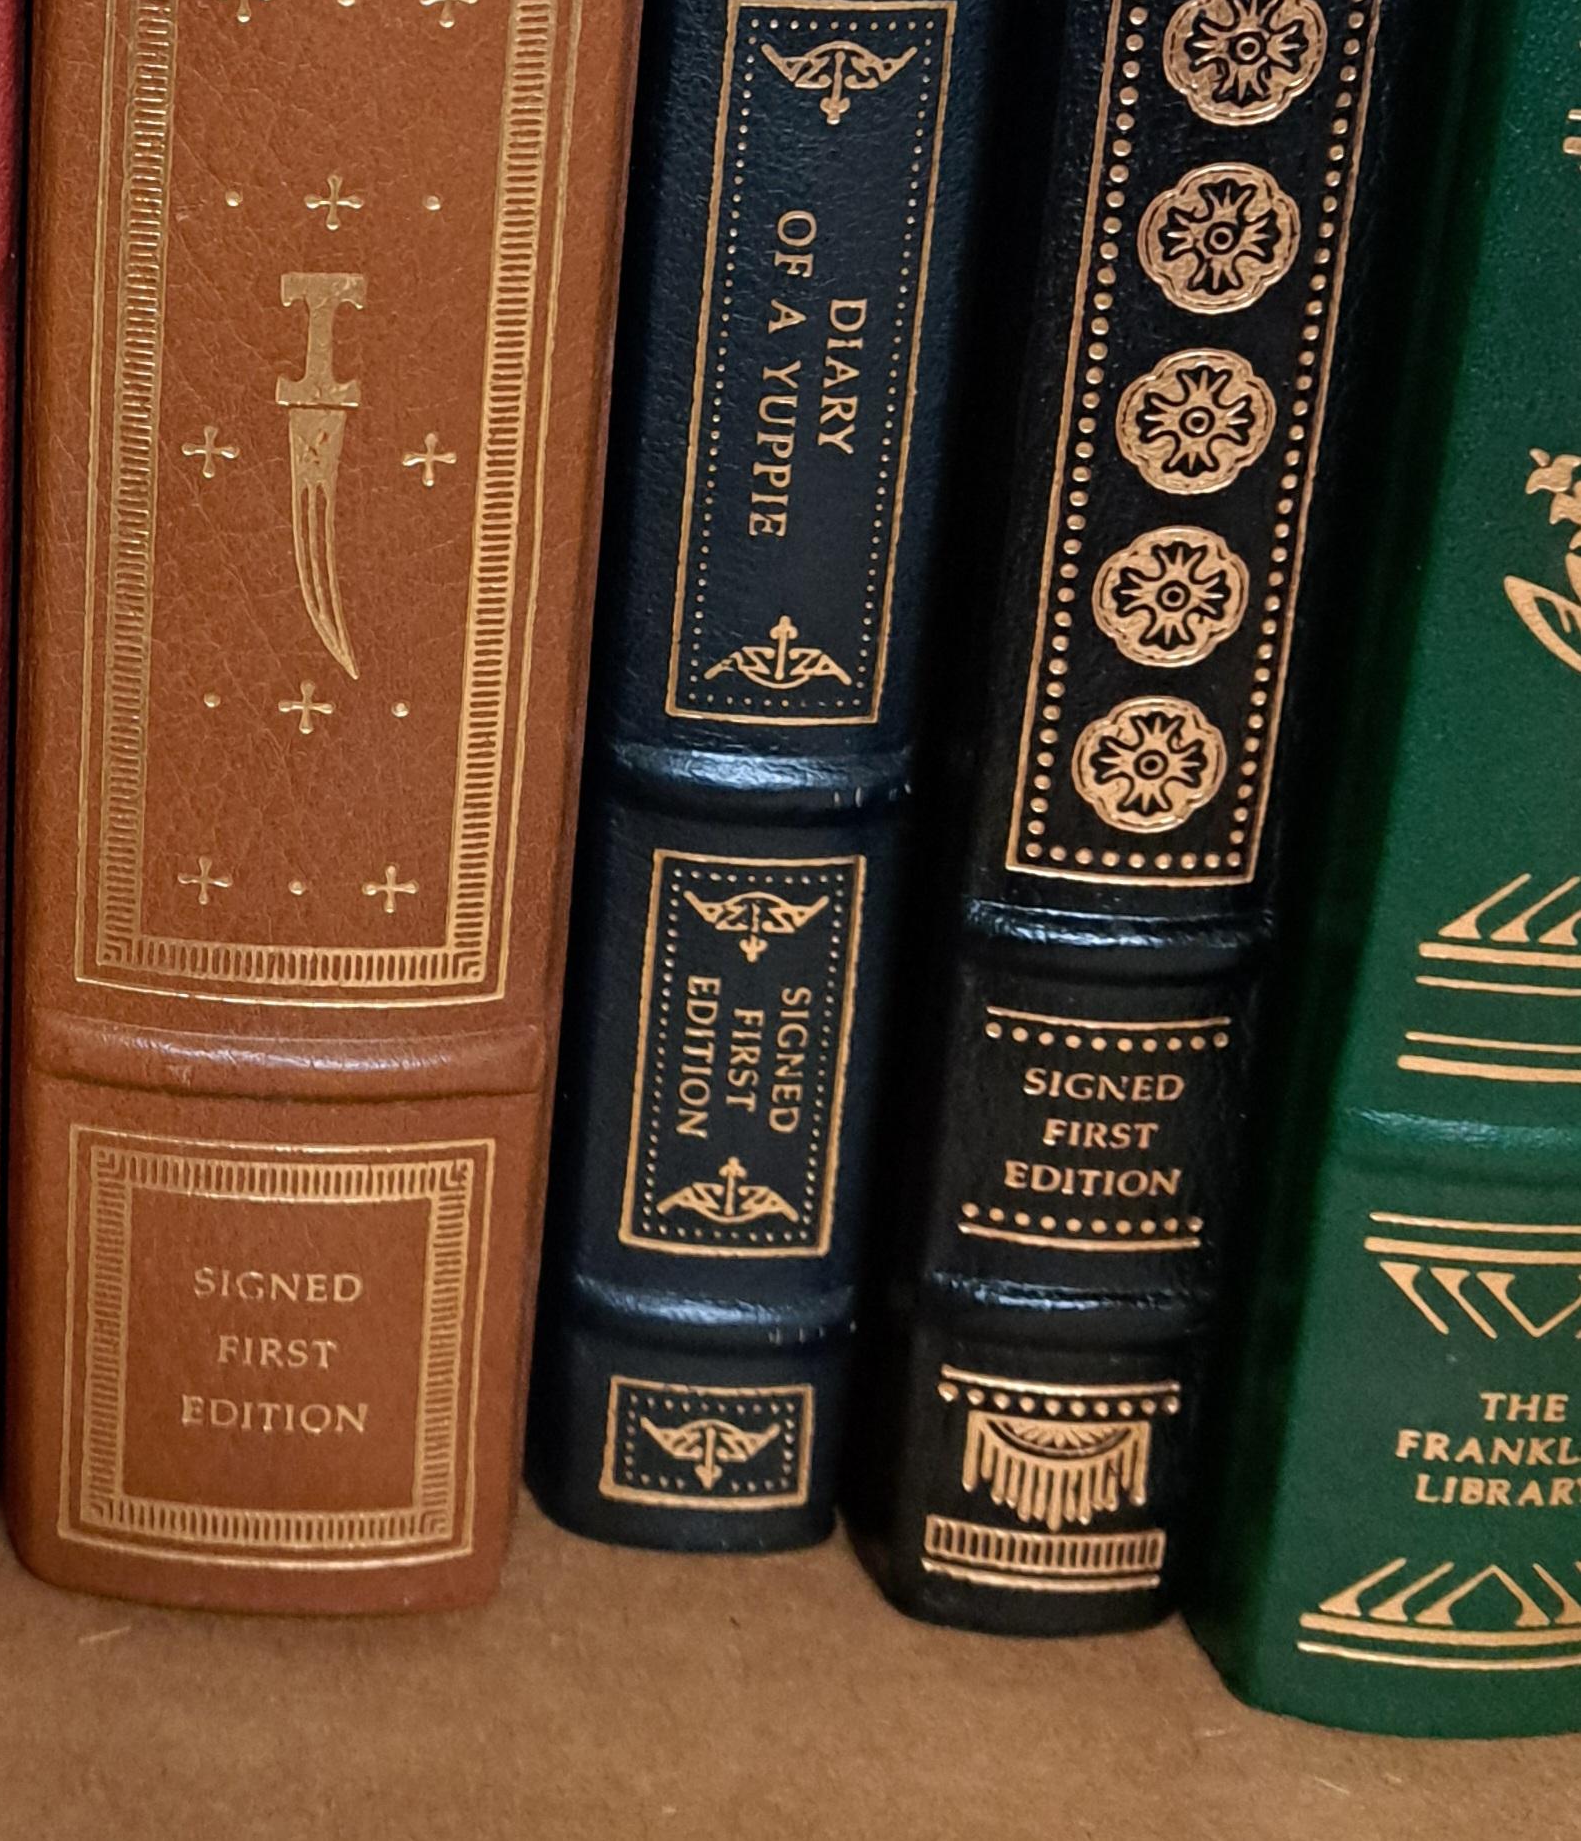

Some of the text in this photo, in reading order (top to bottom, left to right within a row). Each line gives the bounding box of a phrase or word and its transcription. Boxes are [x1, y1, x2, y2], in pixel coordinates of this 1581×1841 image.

[748, 209, 818, 537] OF A YUPPIE
[818, 298, 868, 456] DIARY
[675, 975, 722, 1140] EDITION
[725, 1008, 765, 1113] FIRST
[769, 986, 813, 1135] SIGNED
[1022, 1066, 1186, 1103] SIGNED
[1042, 1117, 1160, 1150] FIRST
[1004, 1159, 1183, 1198] EDITION
[193, 1266, 364, 1303] SIGNED
[217, 1334, 338, 1370] FIRST
[181, 1394, 369, 1434] EDITION
[1479, 1391, 1570, 1423] THE
[1415, 1473, 1581, 1507] LIBRAR
